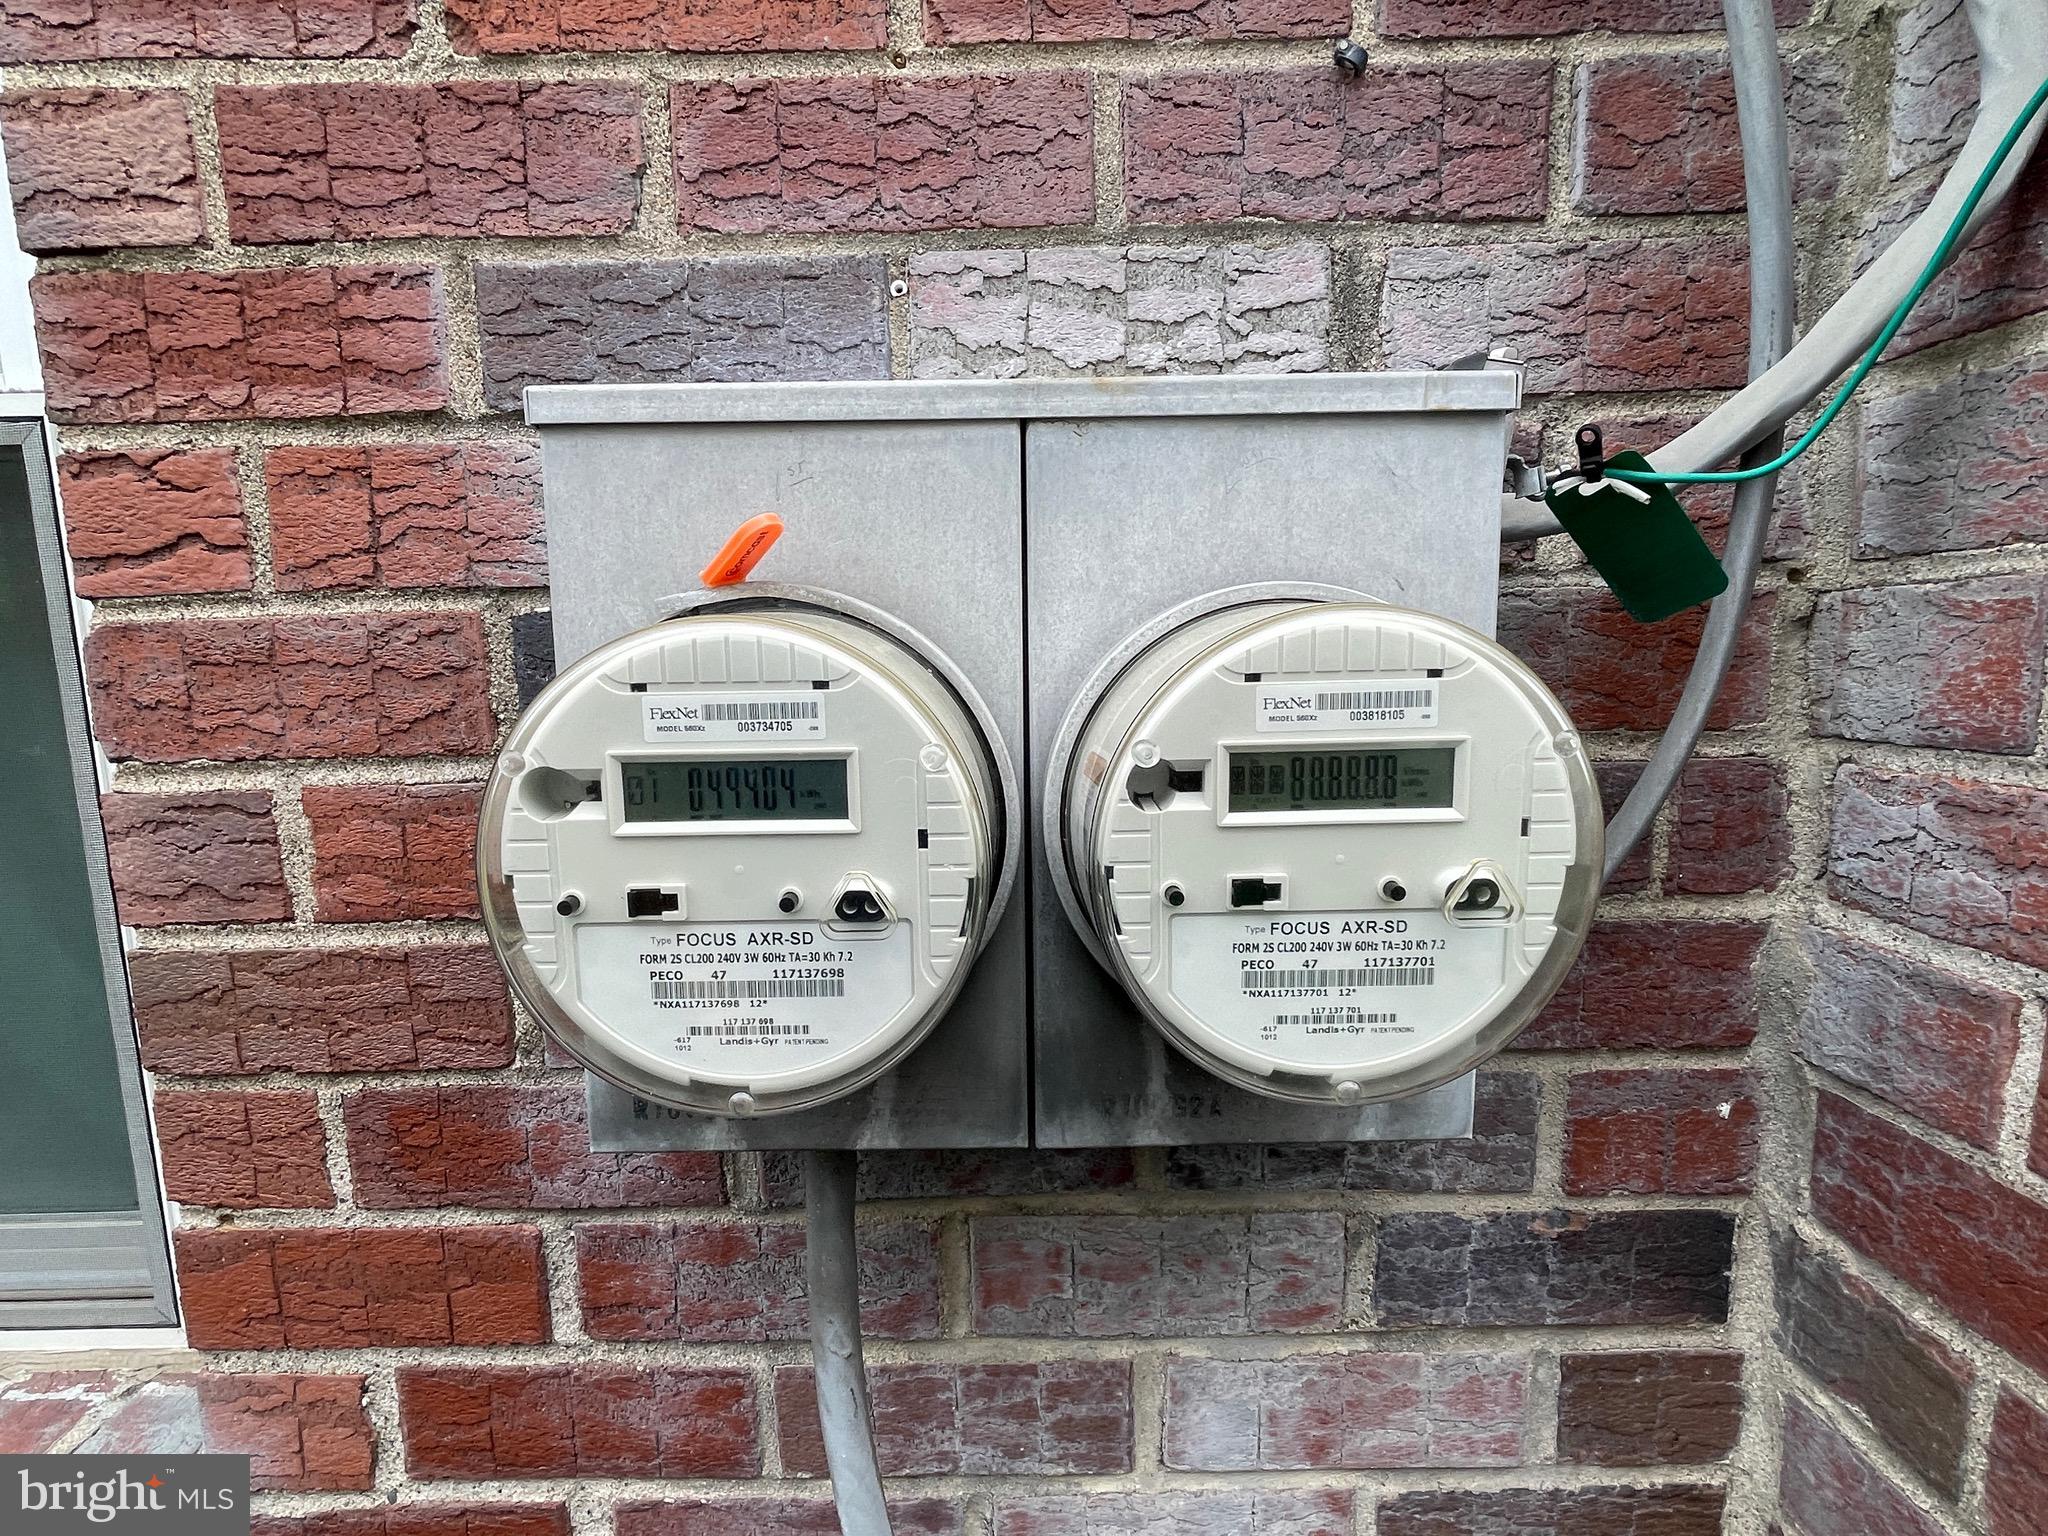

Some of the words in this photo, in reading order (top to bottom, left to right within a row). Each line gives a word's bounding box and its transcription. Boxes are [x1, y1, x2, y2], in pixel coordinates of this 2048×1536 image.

[1263, 697, 1312, 710] FlexNet
[650, 707, 698, 720] FlexNet
[1268, 714, 1295, 722] MODEL
[1350, 710, 1405, 721] 003818105
[737, 721, 793, 732] 003734705
[1245, 925, 1265, 935] Type
[1270, 921, 1330, 935] FOCUS
[1341, 920, 1408, 934] AXR-SD
[651, 936, 671, 946] Type
[676, 933, 736, 946] FOCUS
[747, 932, 813, 946] AXR-SD
[1232, 943, 1260, 954] FORM
[1263, 942, 1275, 953] 2S
[1277, 942, 1307, 952] CL200
[1310, 941, 1334, 952] 240V
[1336, 941, 1351, 951] 3W
[1354, 941, 1379, 951] 60Hz
[1382, 940, 1413, 951] TA=30
[1416, 940, 1429, 950] Kh
[1431, 940, 1446, 950] 7.2
[640, 954, 667, 964] FORM
[670, 953, 682, 964] 2S
[684, 953, 714, 964] CL200
[718, 953, 741, 963] 240V
[744, 952, 759, 963] 3W
[762, 952, 786, 963] 60Hz
[789, 952, 820, 962] TA=30
[823, 951, 836, 962] Kh
[838, 951, 853, 962] 7.2
[1241, 960, 1275, 970] PECO
[1302, 959, 1318, 969] 47
[1364, 957, 1435, 968] 117137701
[650, 971, 683, 981] PECO
[711, 970, 727, 980] 47
[772, 968, 845, 979] 117137698
[723, 1018, 738, 1026] 117
[1306, 1025, 1364, 1035] Landis+Gyr
[719, 1037, 779, 1046] Landis+Gyr
